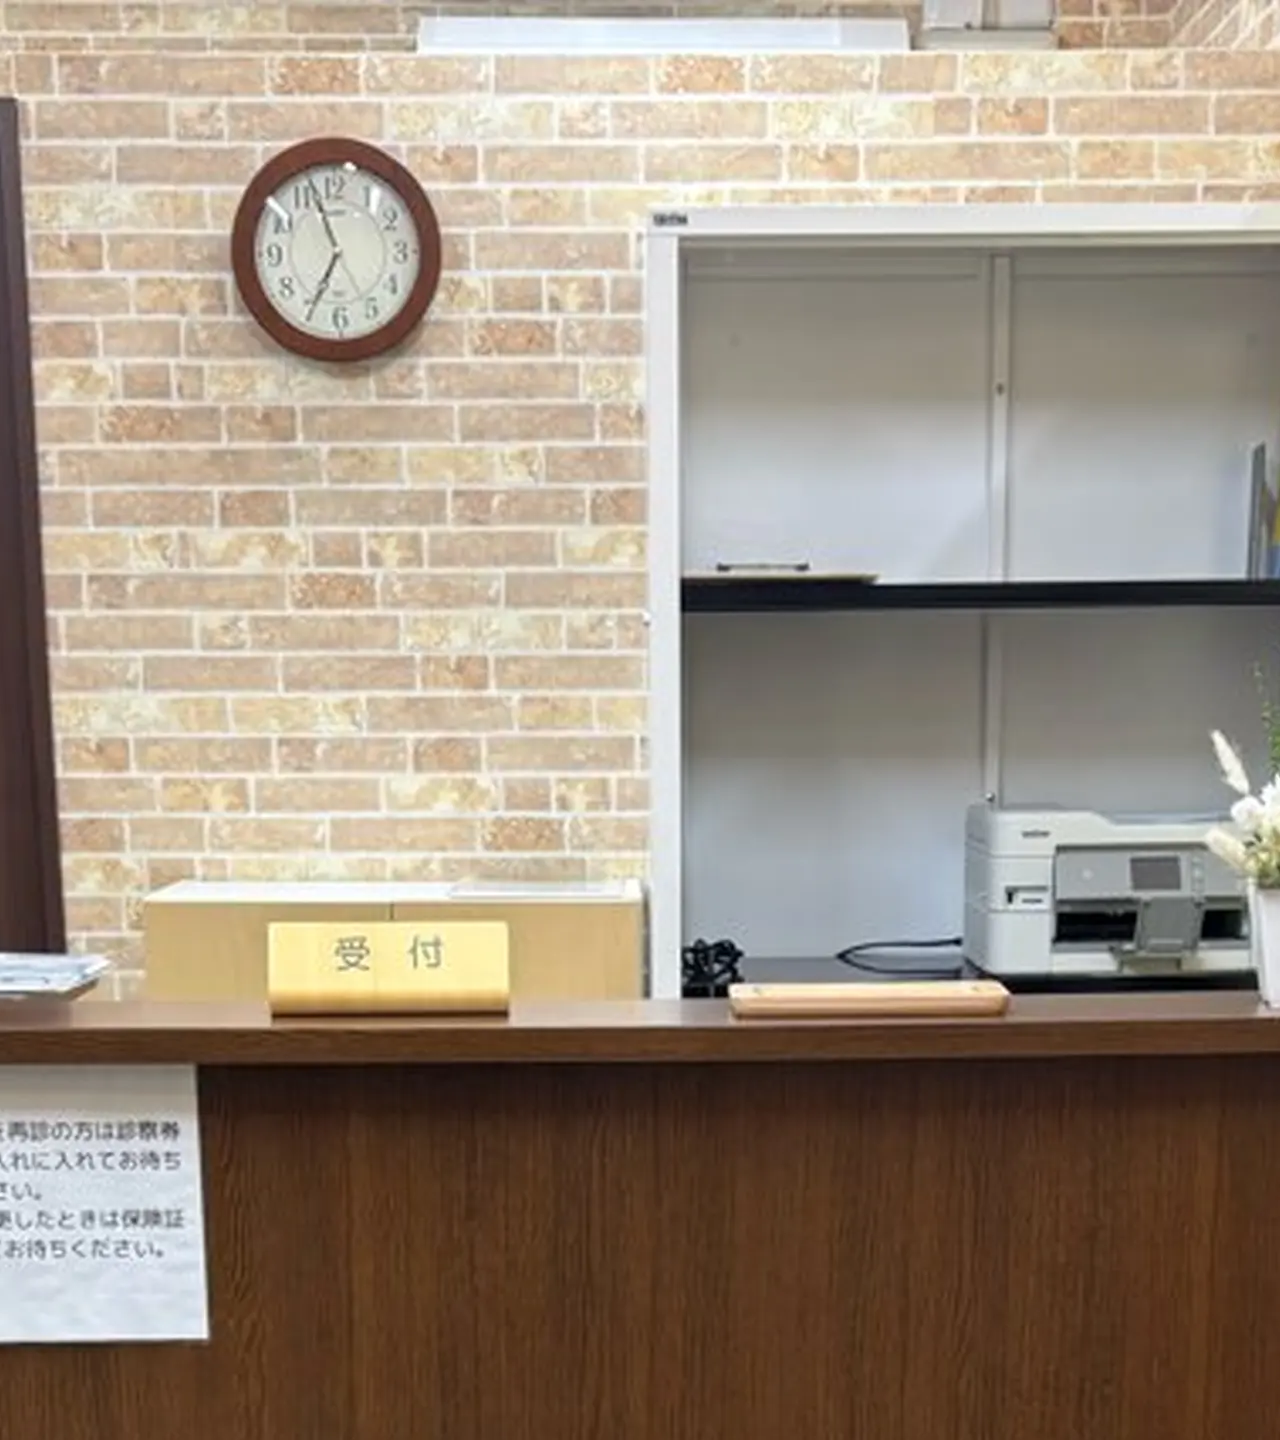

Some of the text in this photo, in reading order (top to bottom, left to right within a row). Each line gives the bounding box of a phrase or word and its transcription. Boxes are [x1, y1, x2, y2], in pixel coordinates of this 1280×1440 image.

[325, 176, 345, 199] 12
[383, 208, 397, 231] 2
[266, 244, 283, 267] 9
[394, 240, 408, 263] 3
[279, 277, 295, 298] 8
[383, 274, 398, 295] 4
[332, 306, 349, 328] 6
[365, 298, 378, 319] 5
